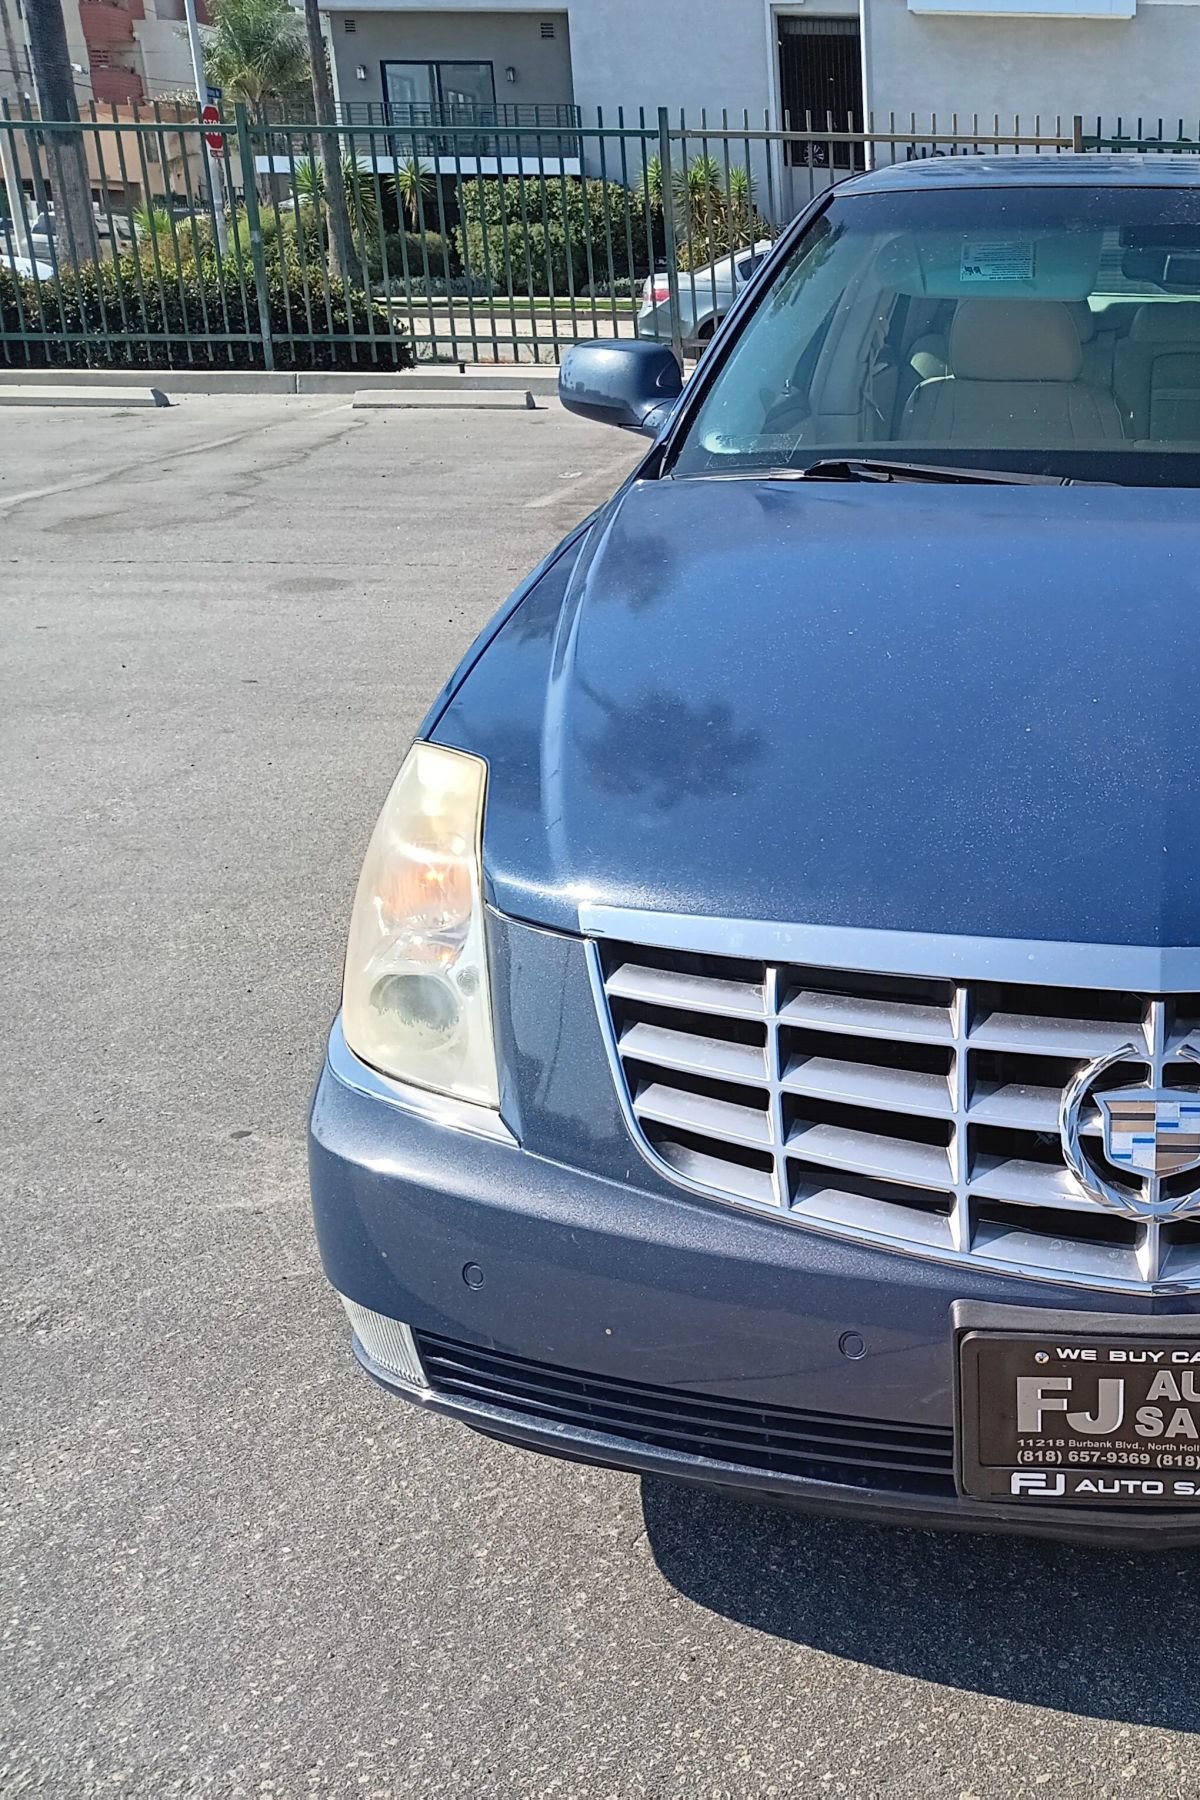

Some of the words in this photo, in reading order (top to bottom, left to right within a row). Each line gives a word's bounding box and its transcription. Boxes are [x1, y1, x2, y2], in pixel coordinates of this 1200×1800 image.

[1056, 1348, 1098, 1360] WE
[1108, 1350, 1165, 1363] BUY
[1016, 1376, 1124, 1434] FJ
[1016, 1439, 1065, 1447] 11218
[1068, 1440, 1112, 1449] Burbank
[1116, 1442, 1144, 1451] Blvd.,
[1148, 1443, 1176, 1452] North
[1017, 1450, 1062, 1465] (818)
[1068, 1451, 1150, 1464] 657-9369
[1010, 1472, 1066, 1496] FJ
[1074, 1479, 1164, 1495] AUTO
